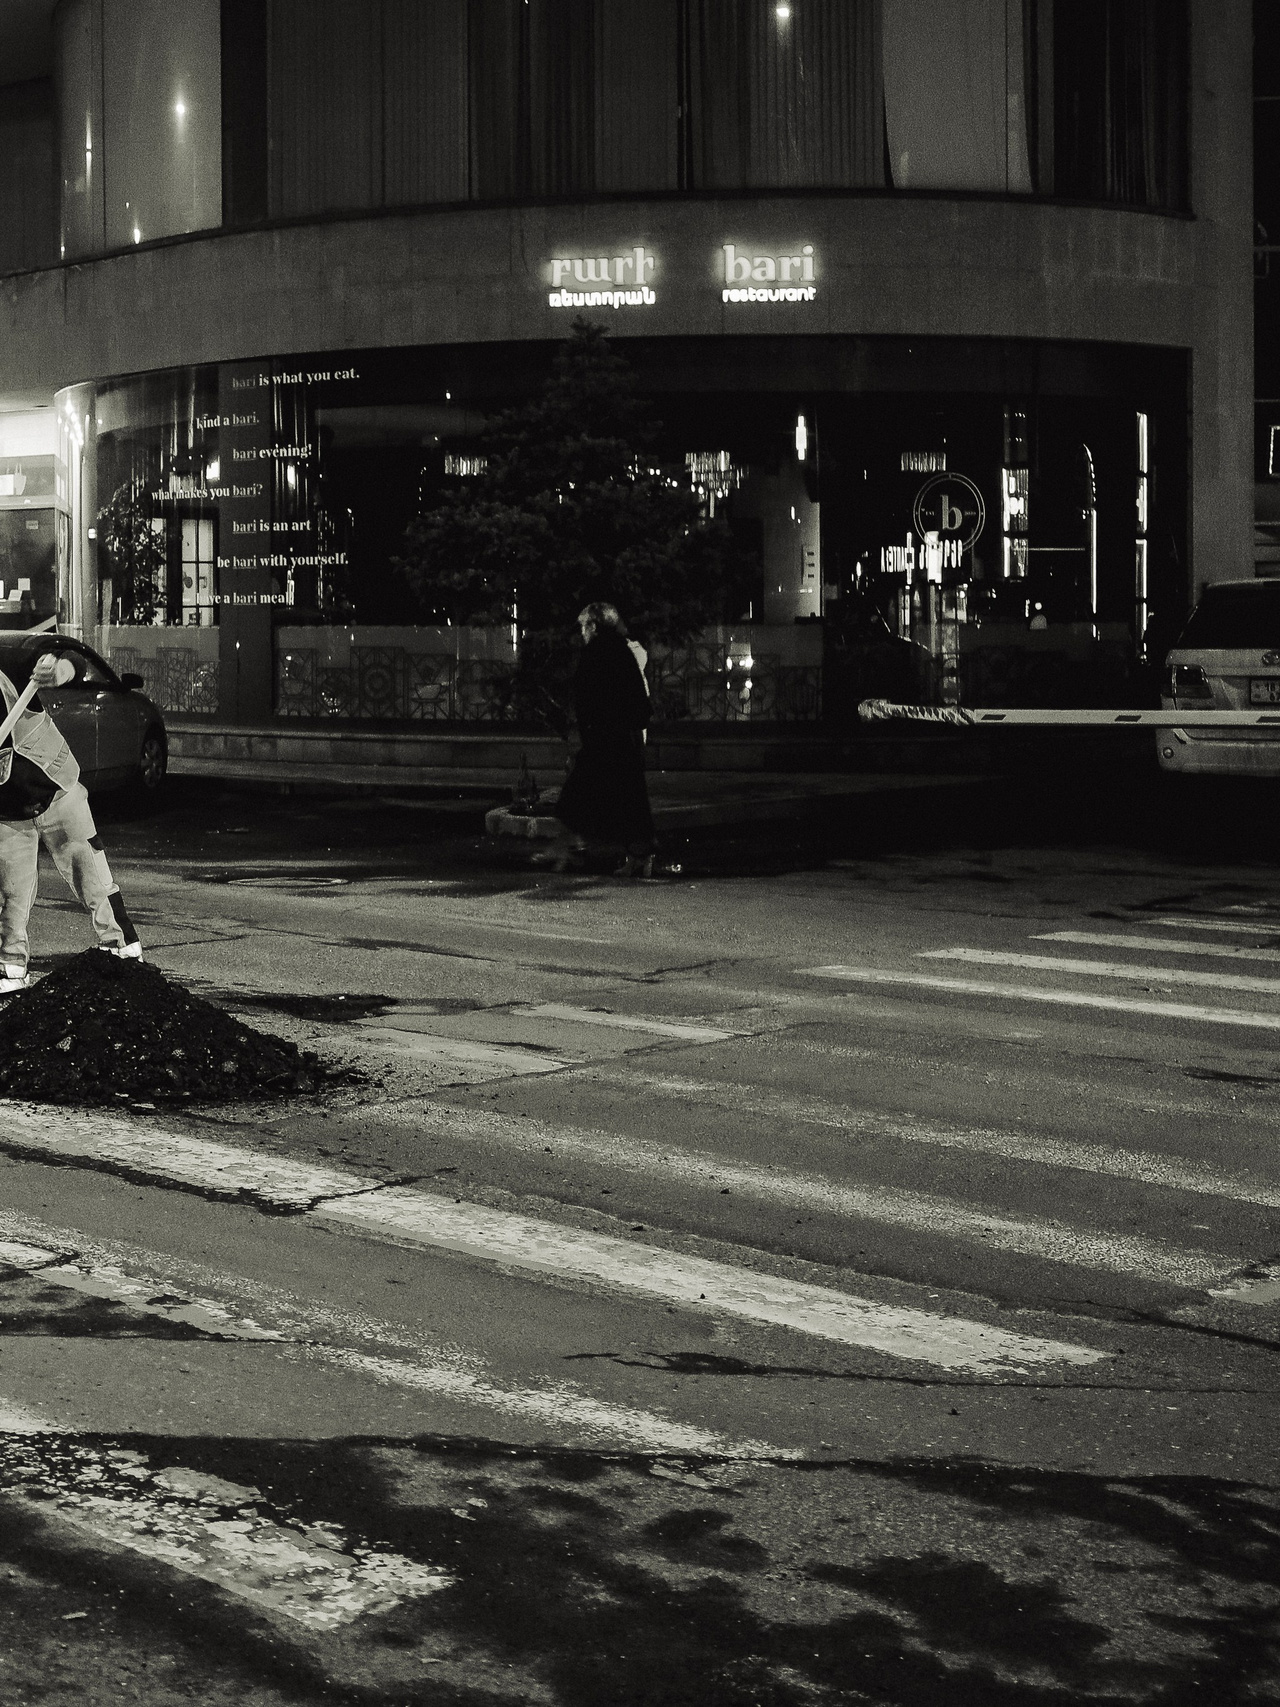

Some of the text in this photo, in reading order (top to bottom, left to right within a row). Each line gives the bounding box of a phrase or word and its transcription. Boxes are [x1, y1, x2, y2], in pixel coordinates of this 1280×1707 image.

[721, 244, 815, 282] bari
[721, 286, 816, 303] restaurant
[232, 367, 360, 389] bari is what you eat.
[195, 411, 259, 429] kind a bari.
[232, 443, 312, 460] bari evening!
[151, 483, 263, 500] what makes you bari?
[232, 519, 311, 532] bari is an art
[217, 552, 349, 569] be bari with yourself.
[223, 593, 231, 604] a
[232, 591, 257, 604] bari
